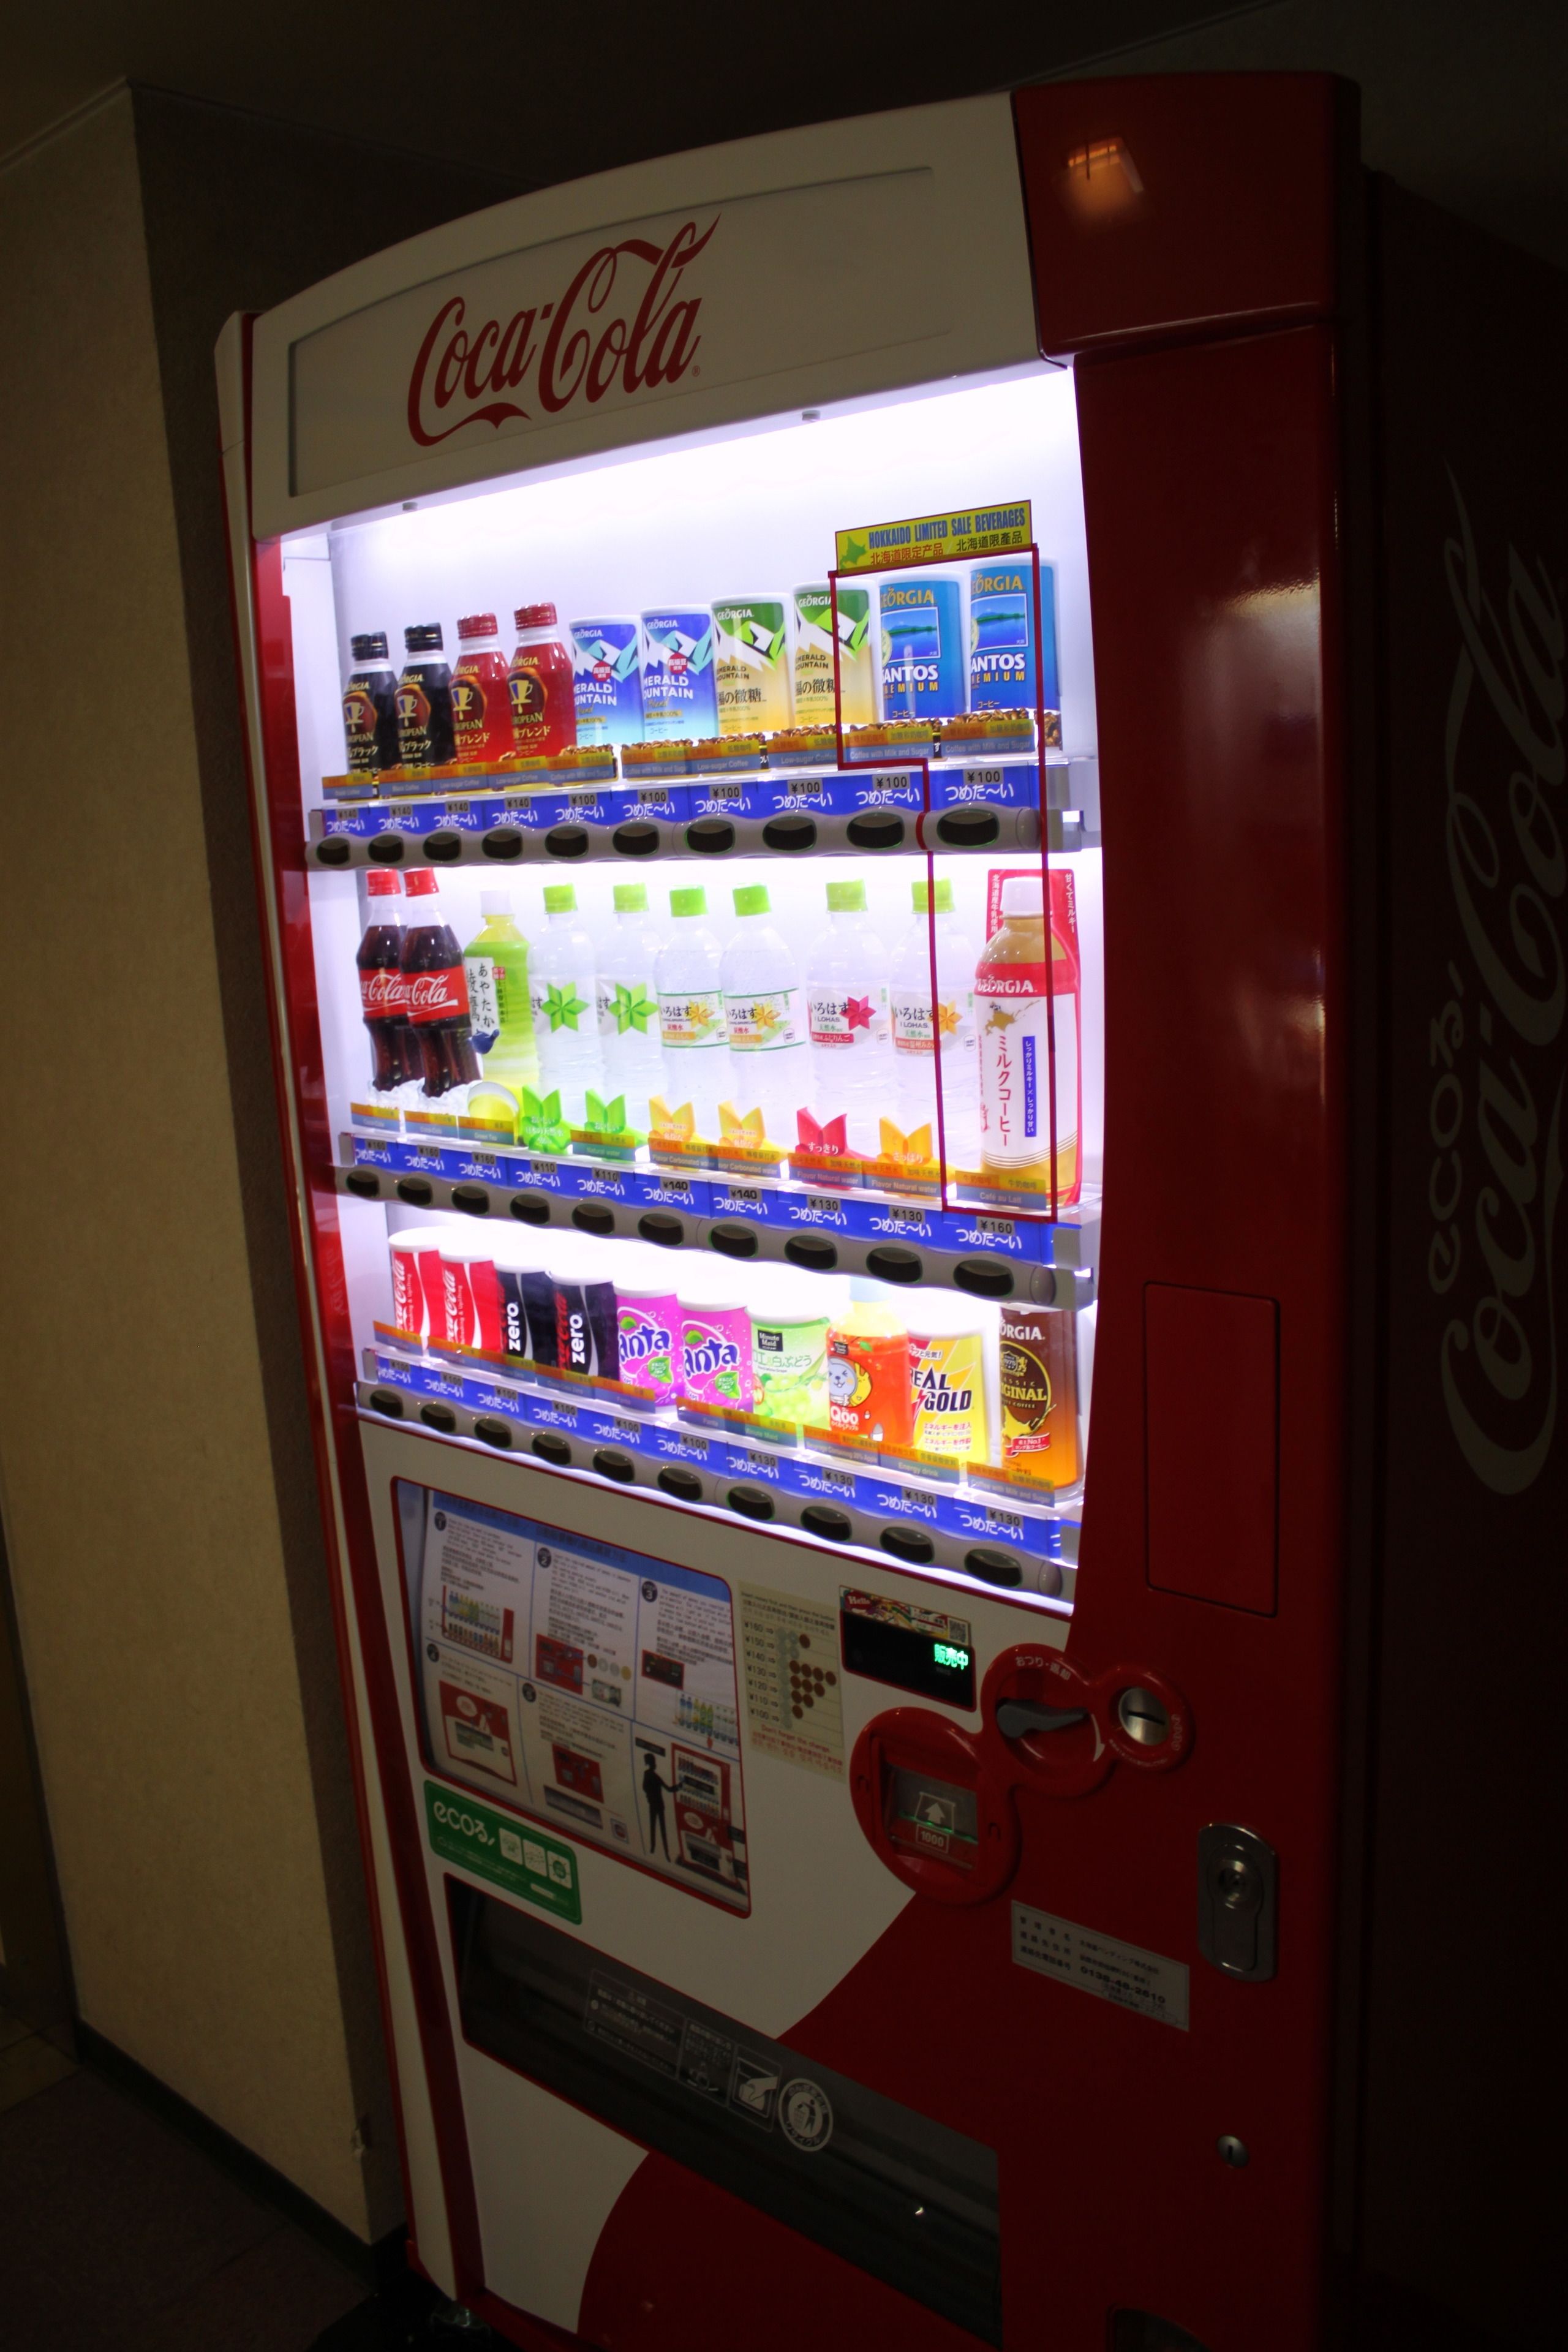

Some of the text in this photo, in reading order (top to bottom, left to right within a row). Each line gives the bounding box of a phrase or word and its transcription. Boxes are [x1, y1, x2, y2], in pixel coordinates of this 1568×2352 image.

[407, 211, 722, 447] Coca-Cola
[869, 507, 1025, 549] HOKKAIDO LIMITED SALE BEVERAGES
[870, 543, 943, 565] 北海道限定产品
[717, 608, 753, 620] GEORGIA
[647, 620, 678, 630] GEORGIA
[971, 652, 1025, 673] ANTOS
[971, 671, 1025, 684] EMIUM
[644, 688, 693, 699] OUNTAIN
[883, 682, 938, 695] EMIUM
[945, 739, 1030, 753] Coffee with Milk and Sugar
[781, 755, 813, 764] Low-sugar
[850, 747, 929, 759] Coffee with Milk and Sugar
[876, 776, 907, 788] ¥100
[967, 771, 1000, 783] ¥100
[712, 787, 740, 798] ¥100
[791, 782, 820, 794] ¥100
[507, 798, 529, 808] ¥140
[571, 794, 595, 805] ¥100
[640, 791, 666, 803] ¥100
[448, 803, 469, 812] ¥140
[1065, 873, 1076, 933] 甘くてミルキー
[1442, 454, 1566, 1495] Coca-Cola
[978, 974, 1034, 993] GEORGIA
[478, 962, 495, 1028] あやたか
[660, 1006, 692, 1017] いろはす
[726, 1009, 757, 1020] いろはす
[812, 1001, 850, 1016] いろはす
[997, 1035, 1012, 1147] ミルクコーヒー
[809, 1142, 839, 1155] すっきり
[669, 1156, 699, 1166] Carbonated
[893, 1152, 923, 1164] さっぱり
[594, 1170, 618, 1182] ¥110
[797, 1171, 858, 1185] Flavor Natural water
[663, 1181, 688, 1191] ¥140
[872, 1180, 938, 1194] Flavor Natural water
[731, 1189, 757, 1200] ¥140
[980, 1192, 995, 1201] Café
[1009, 1195, 1022, 1204] Lait
[810, 1199, 839, 1211] ¥130
[893, 1208, 922, 1222] ¥130
[980, 1219, 1012, 1234] ¥160
[507, 1303, 521, 1352] zero
[1000, 1319, 1042, 1341] ORGIA
[570, 1314, 585, 1364] zero
[760, 1332, 780, 1341] Minute
[619, 1324, 671, 1363] anta
[684, 1338, 739, 1378] anta
[1001, 1382, 1047, 1401] IGINAL
[924, 1390, 972, 1412] GOLD
[831, 1407, 859, 1425] Qoo
[682, 1436, 707, 1449] ¥100
[750, 1453, 776, 1467] ¥130
[899, 1462, 922, 1474] Energy
[824, 1472, 853, 1485] ¥130
[905, 1490, 934, 1505] ¥130
[990, 1510, 1020, 1526] ¥130
[933, 1643, 969, 1671] 販売中
[921, 1831, 944, 1847] 1000
